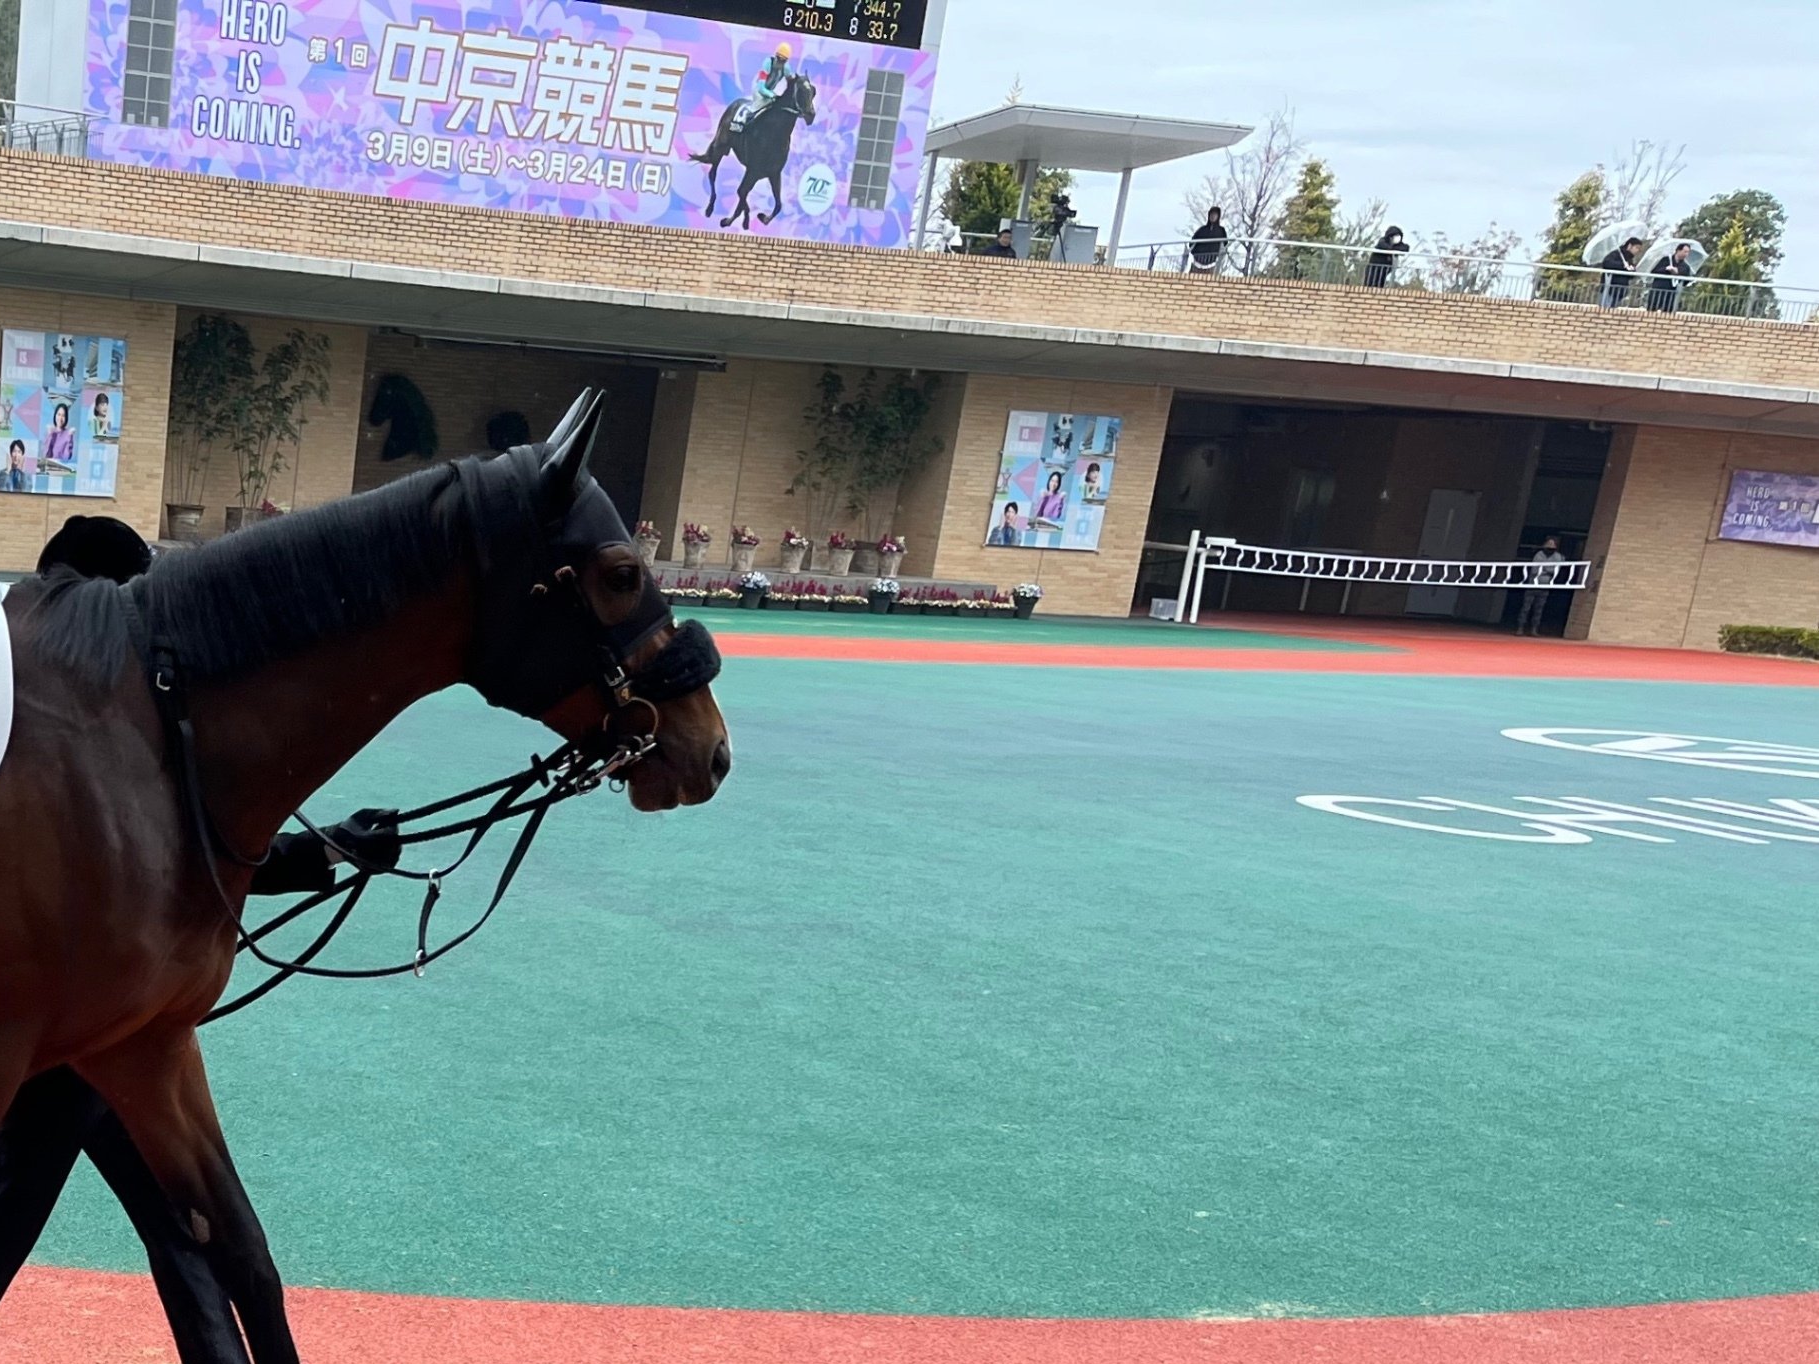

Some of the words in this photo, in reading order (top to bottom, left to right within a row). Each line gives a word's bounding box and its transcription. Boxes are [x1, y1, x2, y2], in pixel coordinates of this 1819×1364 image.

[220, 0, 288, 46] HERO
[783, 7, 793, 26] 8
[794, 9, 834, 31] 210.3
[849, 17, 859, 36] 8
[236, 49, 262, 94] IS
[373, 17, 689, 155] 中京競馬
[191, 95, 301, 149] COMING.
